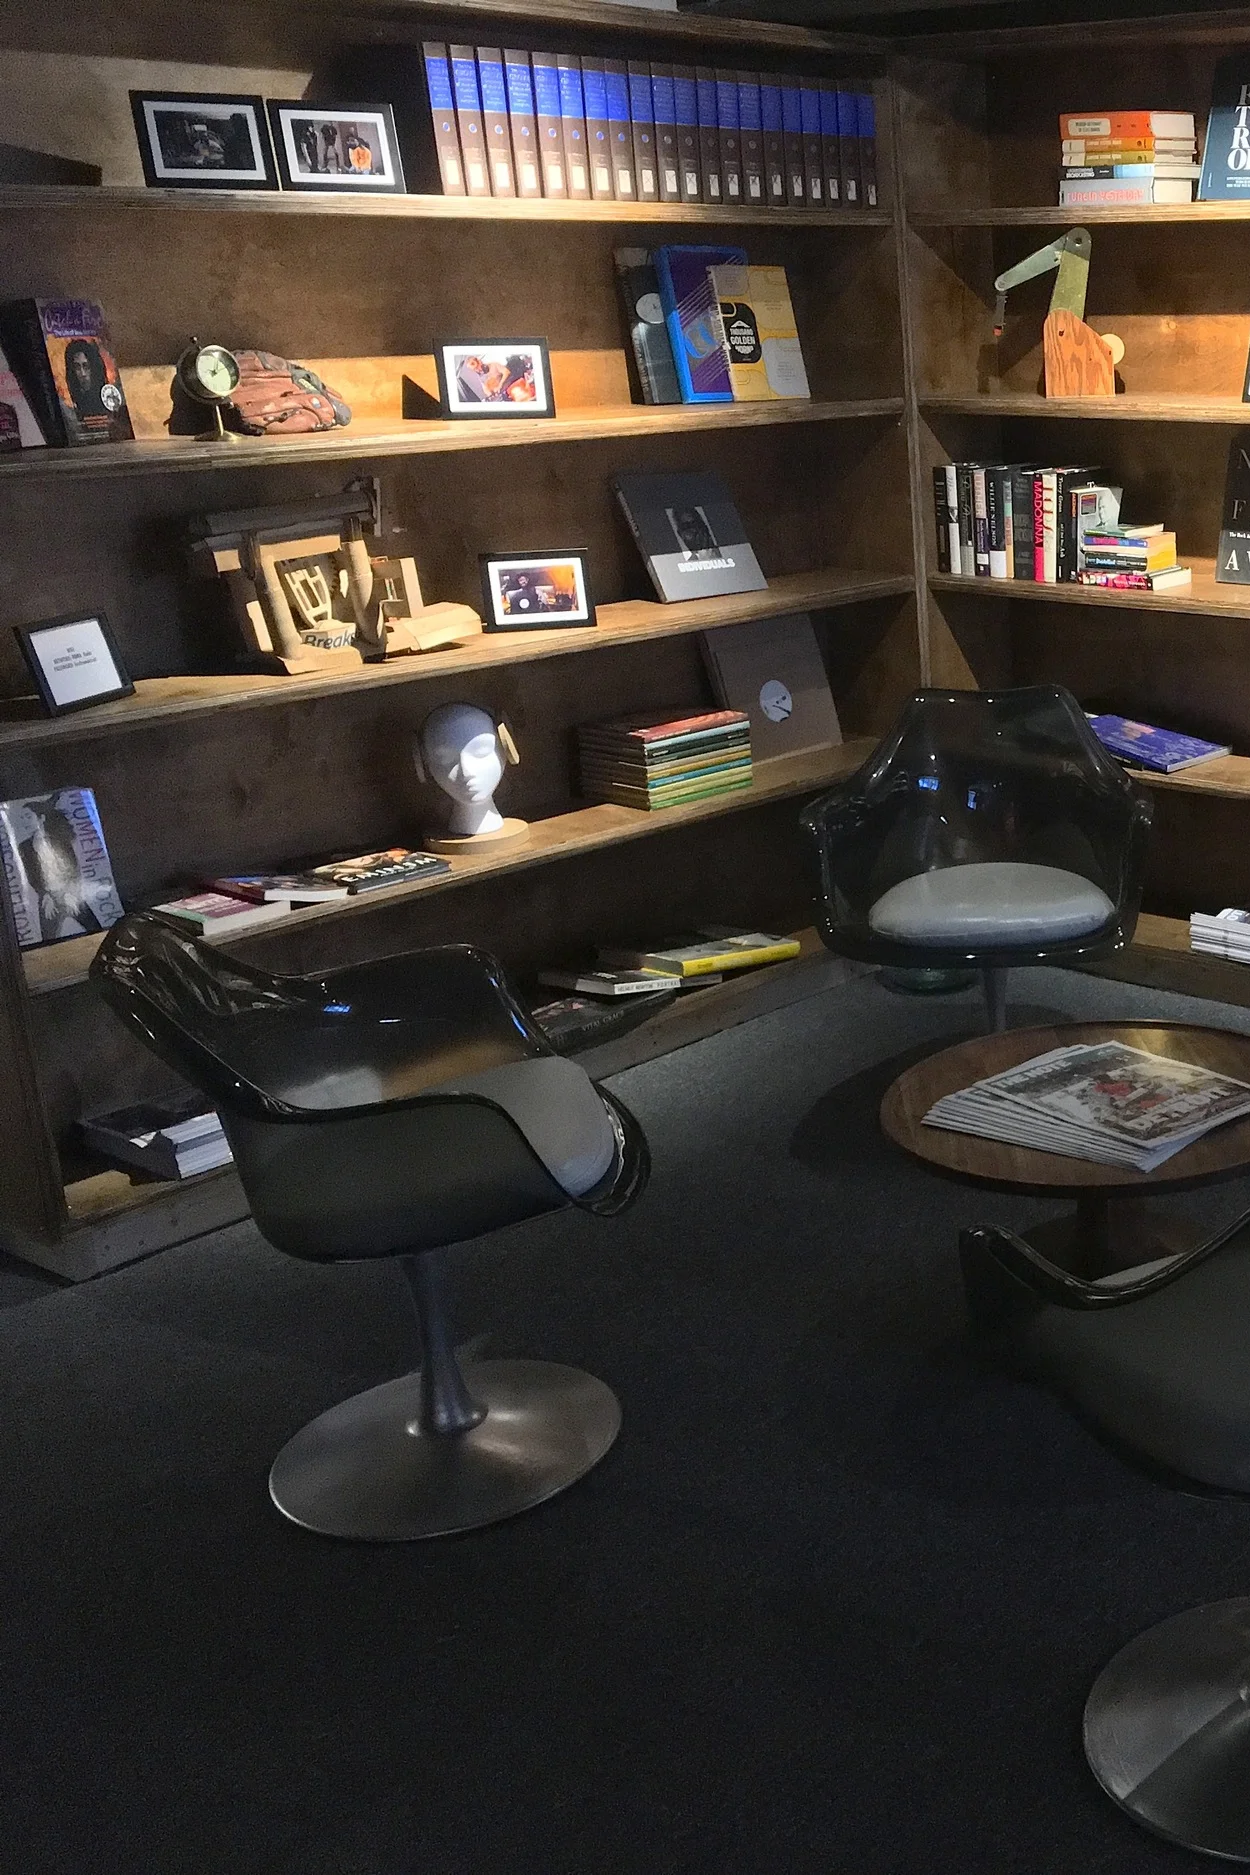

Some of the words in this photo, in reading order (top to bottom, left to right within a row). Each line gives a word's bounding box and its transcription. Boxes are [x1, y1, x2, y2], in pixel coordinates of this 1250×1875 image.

[1098, 187, 1145, 201] YESTERDAY
[730, 336, 756, 346] GOLDEN
[1033, 480, 1044, 545] MADONNA
[990, 514, 998, 547] NELSON
[677, 558, 736, 573] INDIVIDUALS
[69, 789, 106, 863] WOMEN
[81, 863, 98, 879] in
[656, 981, 680, 989] PORTRA
[1001, 1072, 1034, 1088] THE
[1034, 1059, 1072, 1080] NOTE
